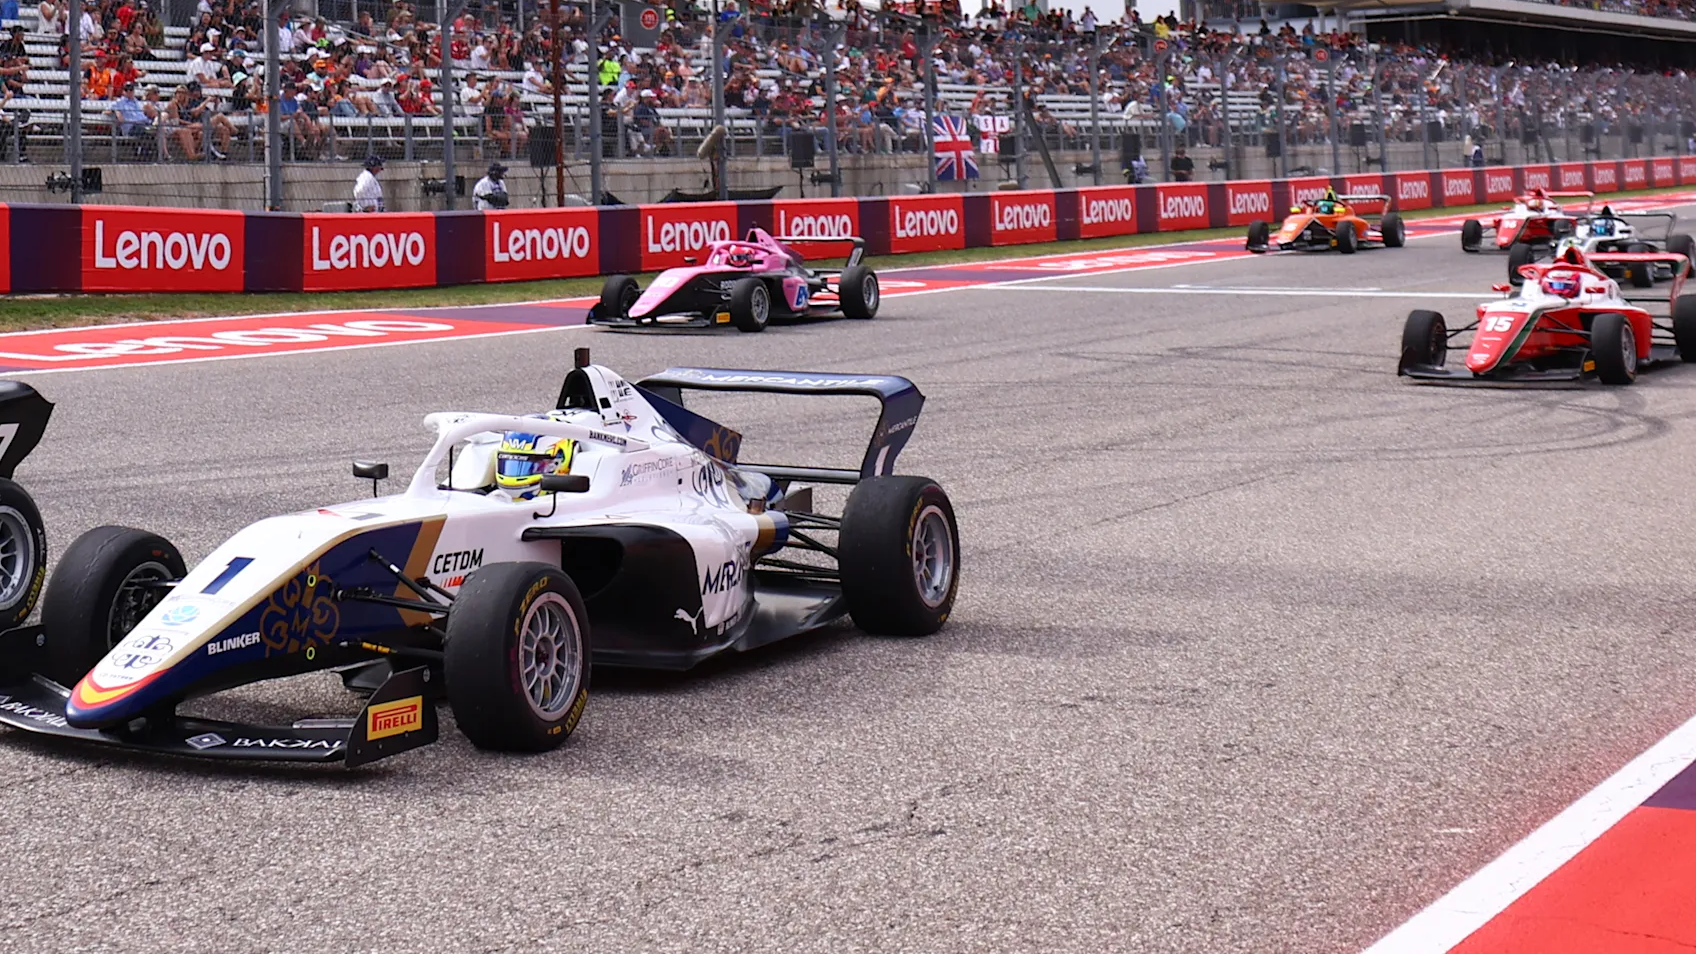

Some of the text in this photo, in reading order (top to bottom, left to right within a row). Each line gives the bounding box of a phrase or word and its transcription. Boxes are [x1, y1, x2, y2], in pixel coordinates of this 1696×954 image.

[1398, 178, 1428, 200] Lenovo
[1443, 176, 1472, 196] Lenovo
[1485, 174, 1512, 193] Lenovo
[994, 199, 1050, 231] Lenovo
[1082, 195, 1132, 224] Lenovo
[1160, 191, 1205, 219] Lenovo
[1229, 188, 1269, 215] Lenovo
[647, 215, 731, 254] Lenovo
[780, 209, 852, 238] Lenovo
[895, 204, 959, 238] Lenovo
[94, 219, 232, 271] Lenovo
[312, 225, 425, 271] Lenovo
[493, 222, 590, 263] Lenovo
[1485, 315, 1515, 333] 15
[200, 555, 255, 595] 1
[433, 548, 484, 575] CETDM
[207, 631, 261, 655] BLINKER
[371, 700, 419, 731] PIRELLI
